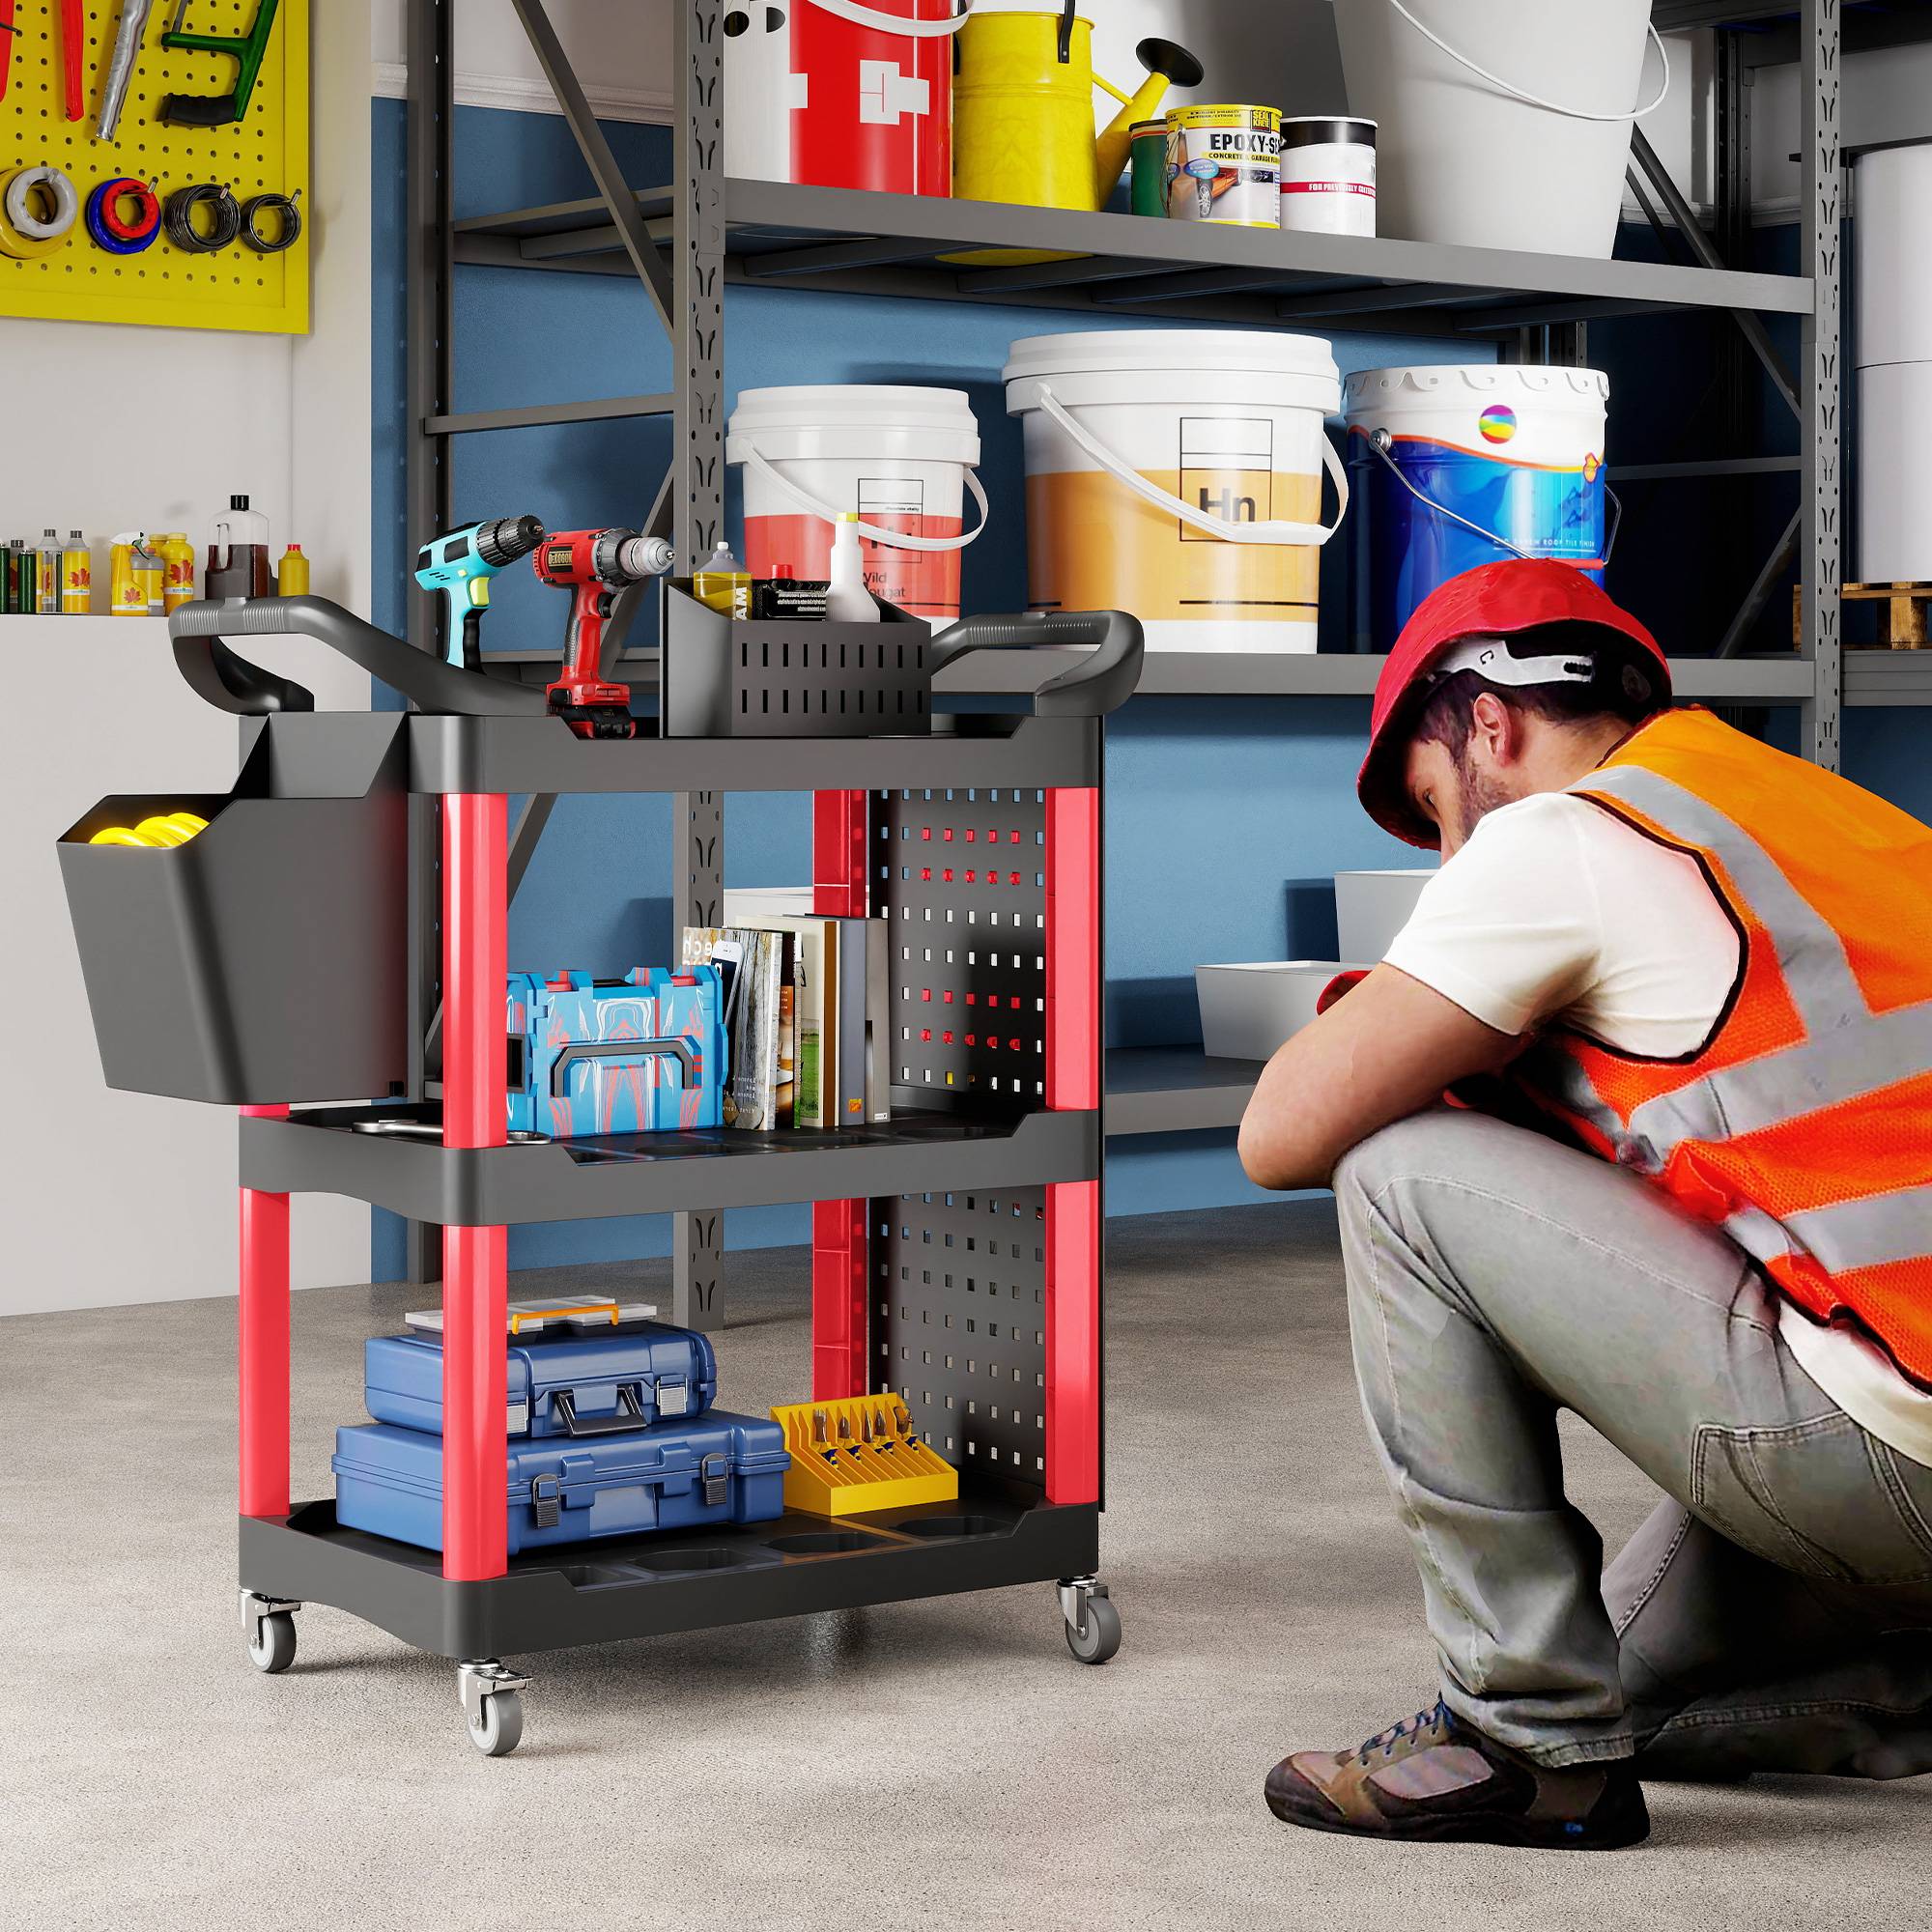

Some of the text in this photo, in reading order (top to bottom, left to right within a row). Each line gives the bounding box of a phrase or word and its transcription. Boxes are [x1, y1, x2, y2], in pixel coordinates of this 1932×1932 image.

[1253, 110, 1269, 119] SEAL
[1309, 183, 1322, 191] FOR
[1200, 487, 1256, 523] Hn
